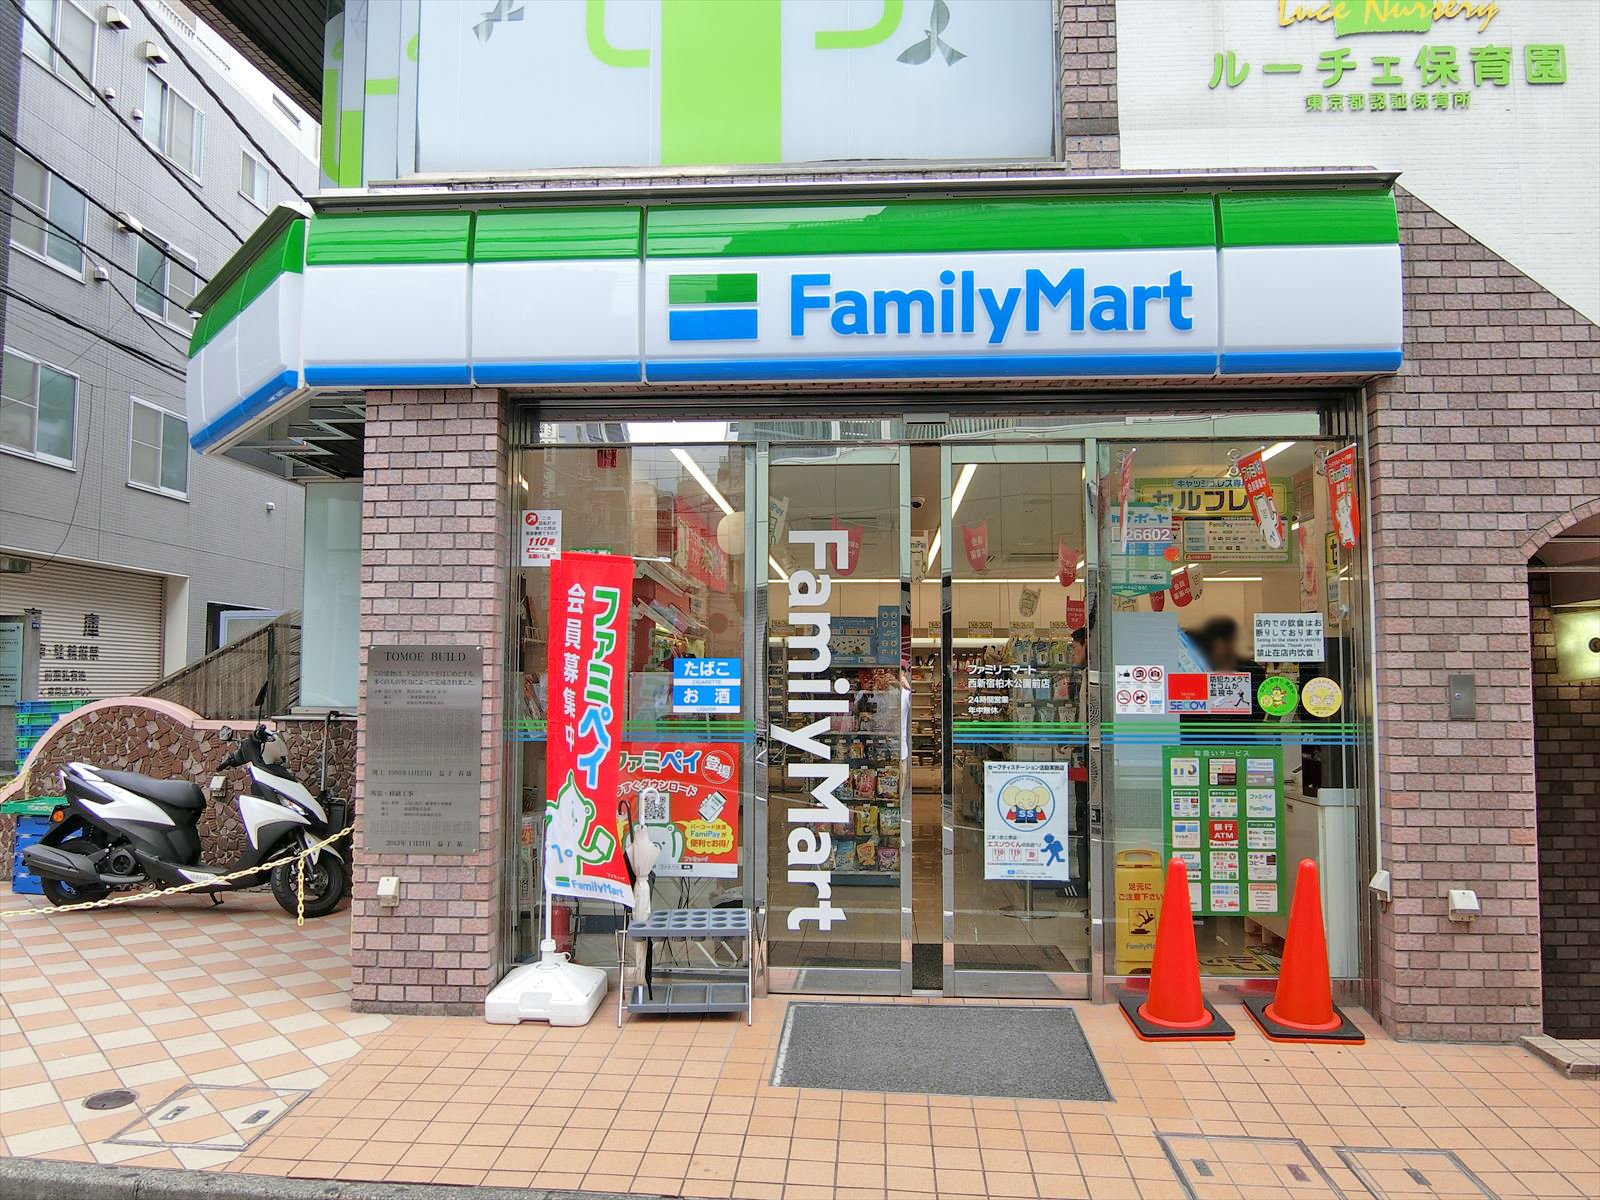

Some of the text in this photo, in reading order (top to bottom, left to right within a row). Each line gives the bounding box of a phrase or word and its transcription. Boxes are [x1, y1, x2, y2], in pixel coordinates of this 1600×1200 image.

[1208, 44, 1568, 89] ルーチェ保育園
[1305, 92, 1472, 112] 東京都認証保育所
[790, 268, 1193, 345] FamilyMart
[1152, 489, 1250, 511] セルフレ
[1255, 619, 1322, 627] 店内での飲食はお
[384, 652, 466, 662] TOMOE BUILD
[563, 583, 586, 753] 会員募集中
[684, 660, 730, 676] たばこ
[968, 664, 1037, 675] ファミリーマート
[577, 585, 620, 790] ファミペイ
[968, 679, 1050, 689] 西新宿柏木公園前店
[683, 688, 730, 704] お酒
[968, 696, 1009, 704] 24時間営業
[968, 706, 999, 715] 年中無休
[1170, 701, 1207, 710] SECOM
[769, 529, 849, 932] FamilyMart
[1194, 749, 1250, 757] 取扱いサービス
[704, 755, 732, 779] 登場
[1018, 810, 1034, 818] SS
[1214, 823, 1233, 831] 銀行
[690, 830, 720, 839] FamiPay
[571, 880, 624, 898] FamilyMart
[1128, 882, 1152, 890] 足元に
[1118, 892, 1164, 901] ご注意下さい
